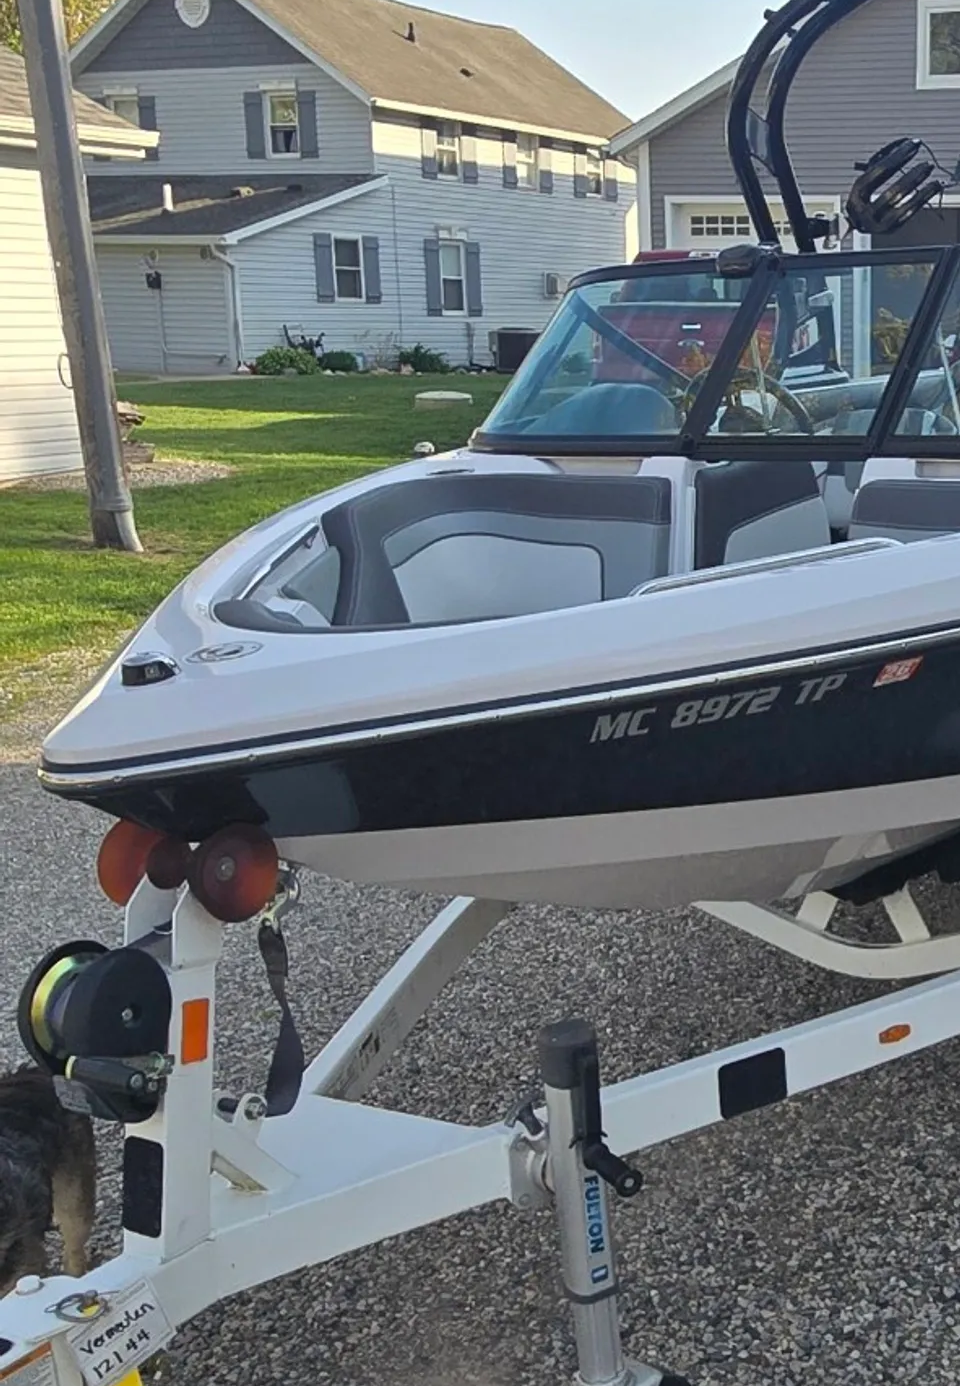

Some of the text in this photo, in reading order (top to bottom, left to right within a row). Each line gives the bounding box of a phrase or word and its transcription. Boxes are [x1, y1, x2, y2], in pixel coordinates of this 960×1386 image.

[589, 673, 848, 743] MC 8972 TP
[583, 1174, 606, 1254] FULTON
